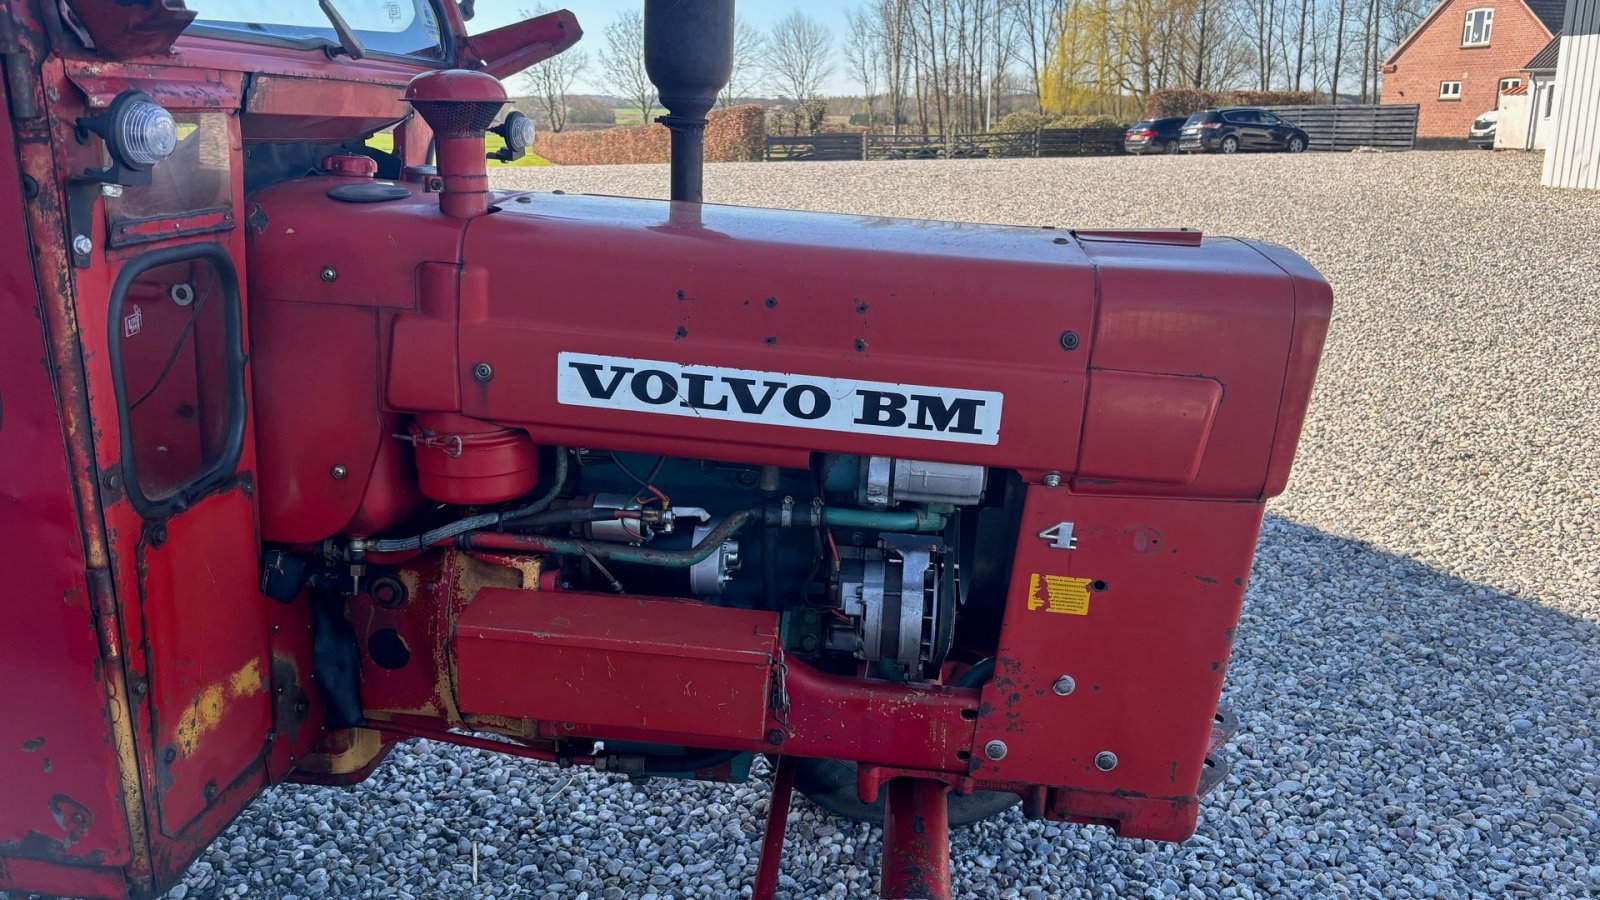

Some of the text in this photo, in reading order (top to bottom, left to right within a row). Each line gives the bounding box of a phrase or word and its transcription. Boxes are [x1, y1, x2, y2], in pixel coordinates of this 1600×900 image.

[569, 361, 986, 435] VOLVO BM
[1038, 521, 1078, 550] 4
